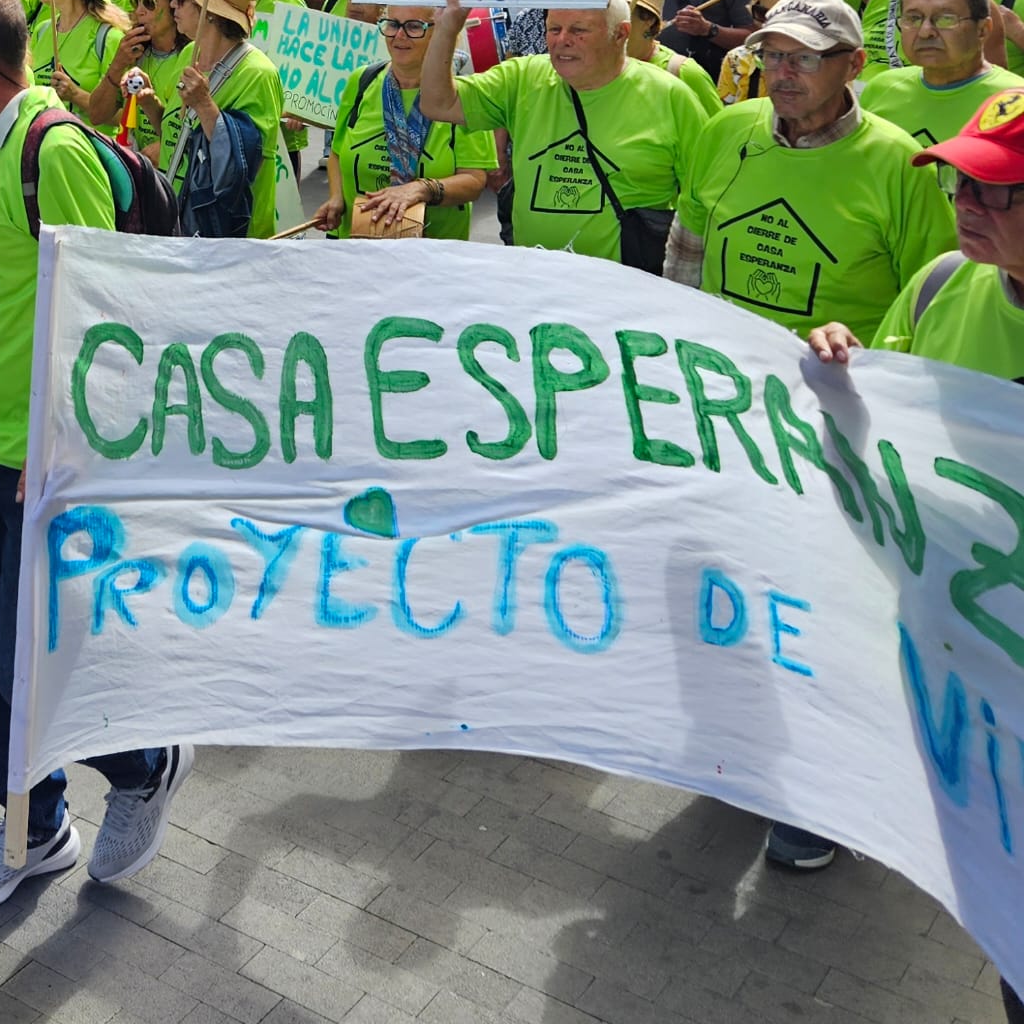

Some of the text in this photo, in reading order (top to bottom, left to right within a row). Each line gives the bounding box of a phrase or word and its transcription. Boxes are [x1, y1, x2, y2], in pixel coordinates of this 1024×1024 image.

[283, 10, 310, 38] LA
[277, 34, 327, 67] HACE
[279, 63, 302, 90] NO
[305, 69, 332, 104] AL
[760, 213, 789, 228] NO AL
[747, 225, 798, 245] CIERRE DE
[739, 252, 796, 274] ESPERANZA
[756, 243, 783, 256] CASA
[72, 321, 334, 469] CASA
[45, 504, 815, 677] PROYECTO DE
